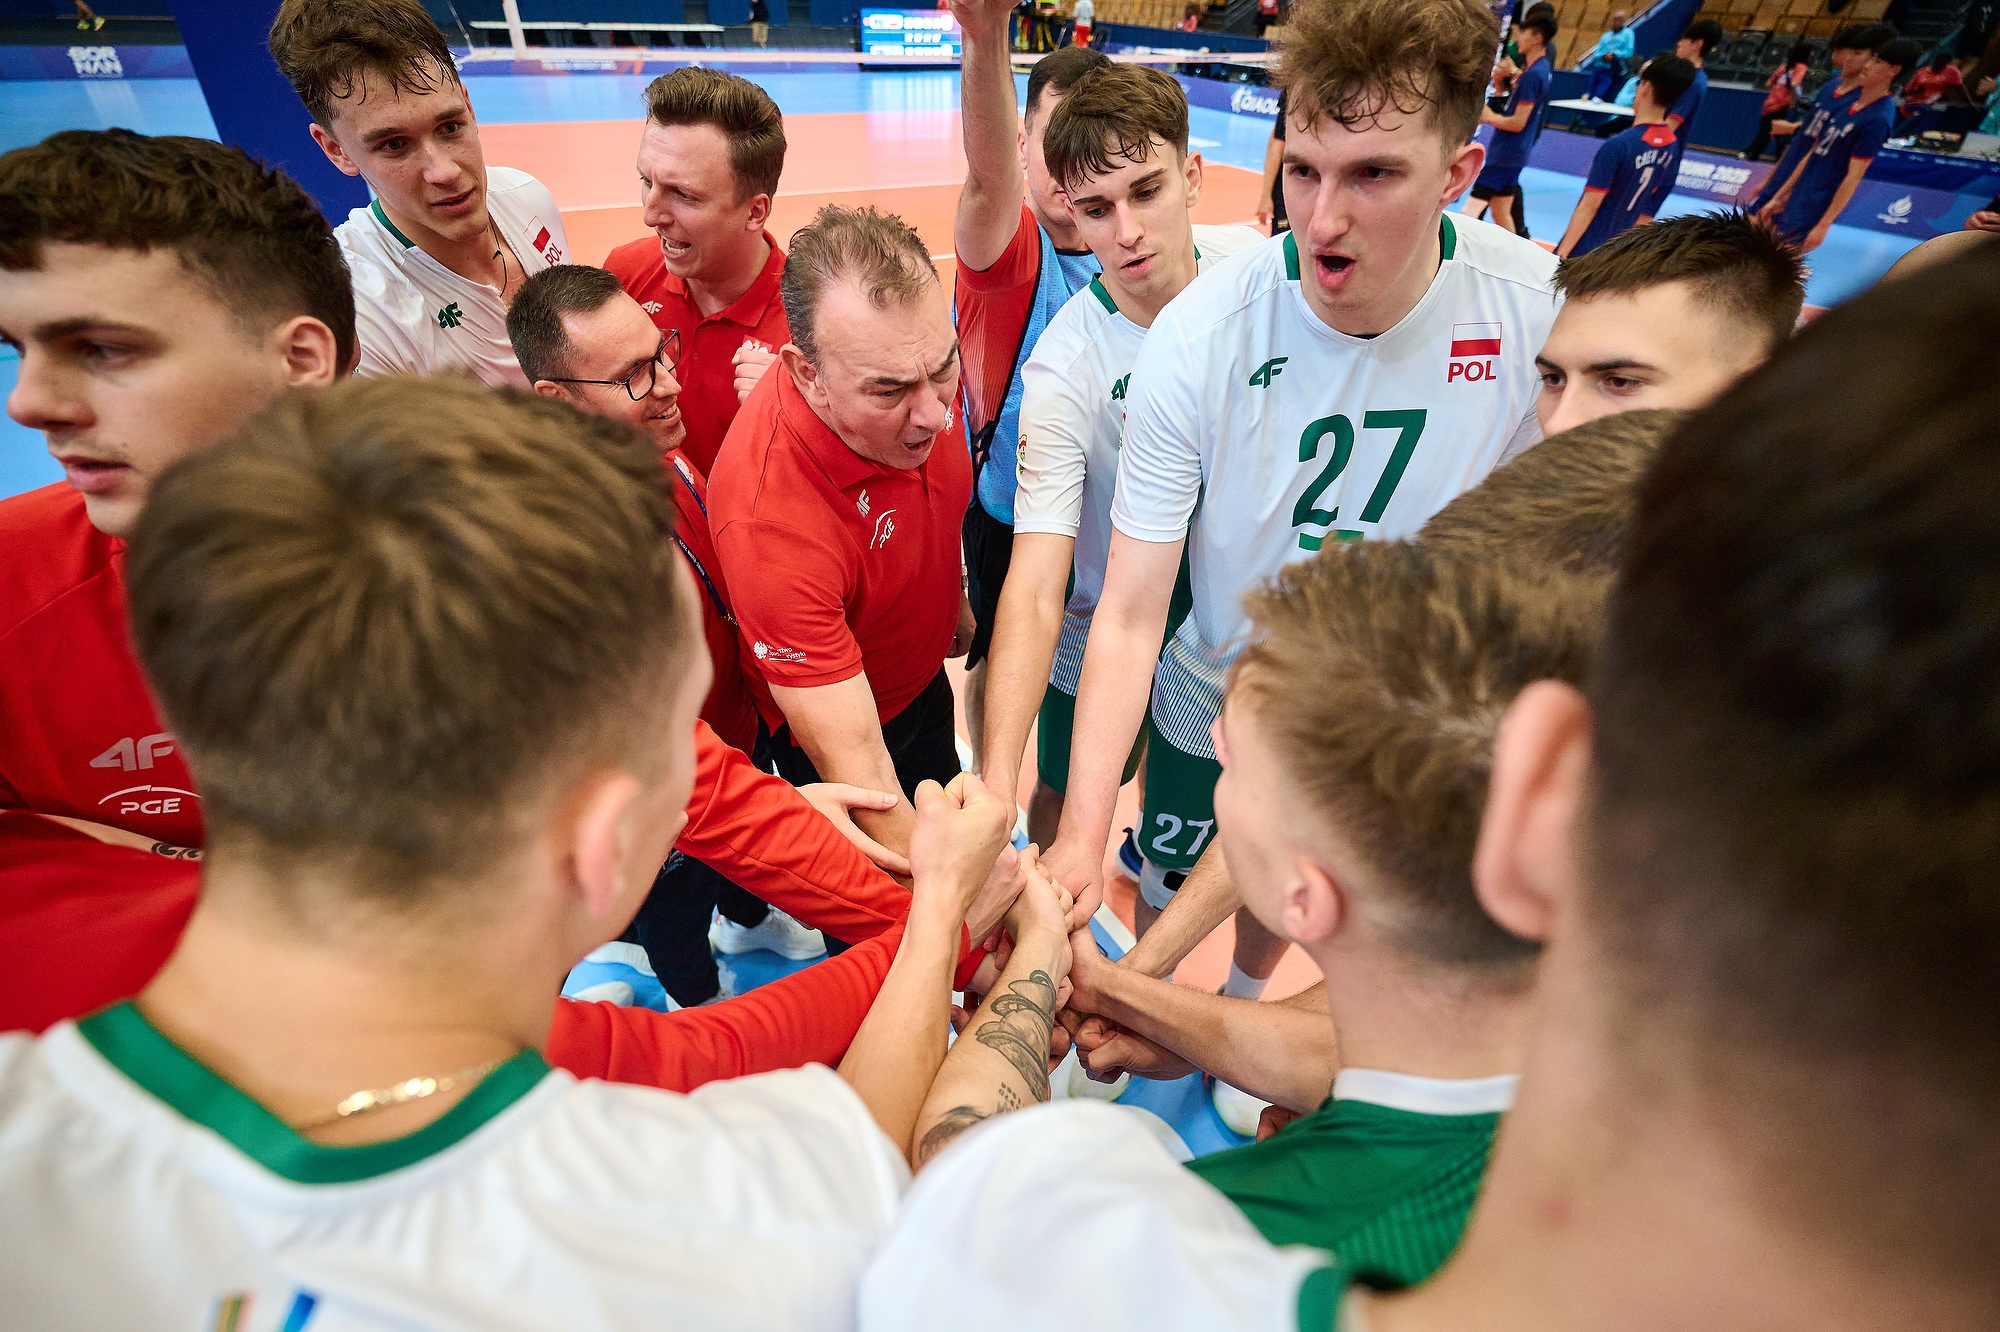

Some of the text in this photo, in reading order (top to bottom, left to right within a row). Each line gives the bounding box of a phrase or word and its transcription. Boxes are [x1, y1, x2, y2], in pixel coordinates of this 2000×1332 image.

[1627, 166, 1655, 212] 7
[545, 242, 563, 267] POL
[642, 300, 664, 315] 4F
[1248, 356, 1289, 389] 4F
[1446, 359, 1498, 384] POL
[1291, 407, 1428, 529] 27
[878, 516, 896, 549] PGE
[89, 731, 177, 772] 4F
[120, 797, 181, 815] PGE
[1150, 812, 1214, 856] 27
